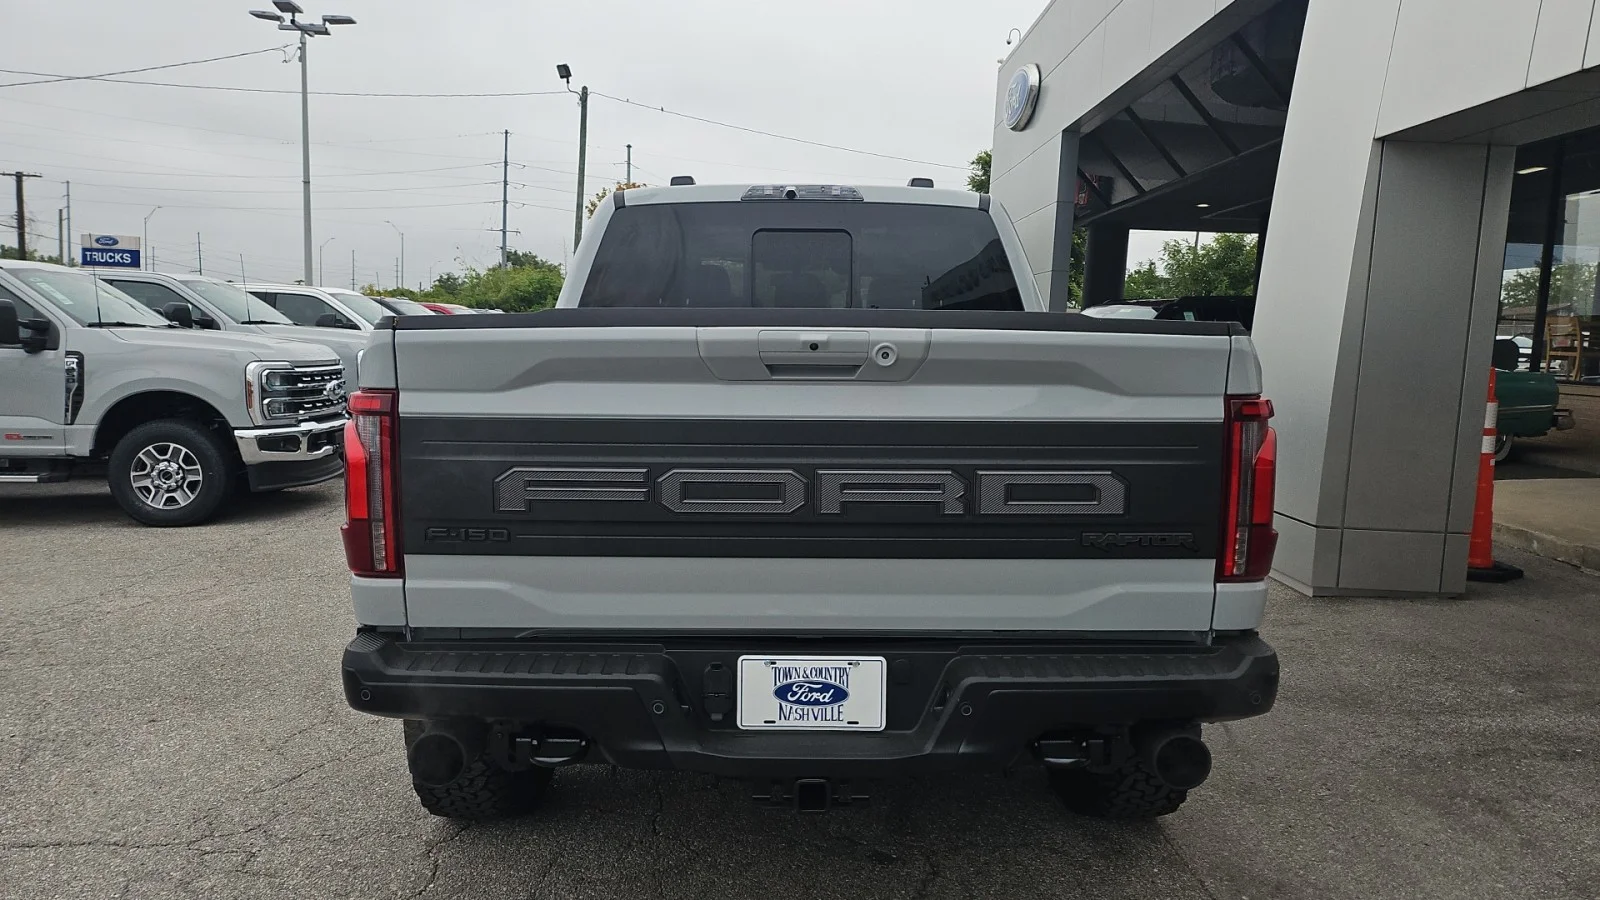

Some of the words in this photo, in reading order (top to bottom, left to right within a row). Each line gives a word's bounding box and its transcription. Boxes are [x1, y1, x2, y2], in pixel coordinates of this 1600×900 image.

[85, 251, 131, 263] TRUCKS
[494, 467, 1127, 515] FORD
[425, 527, 511, 542] F-150
[1081, 532, 1198, 551] RAPTOR
[772, 666, 801, 687] TOWN
[810, 666, 851, 689] COUNTRY
[787, 682, 834, 702] Ford
[779, 702, 844, 721] NASHVILLE
